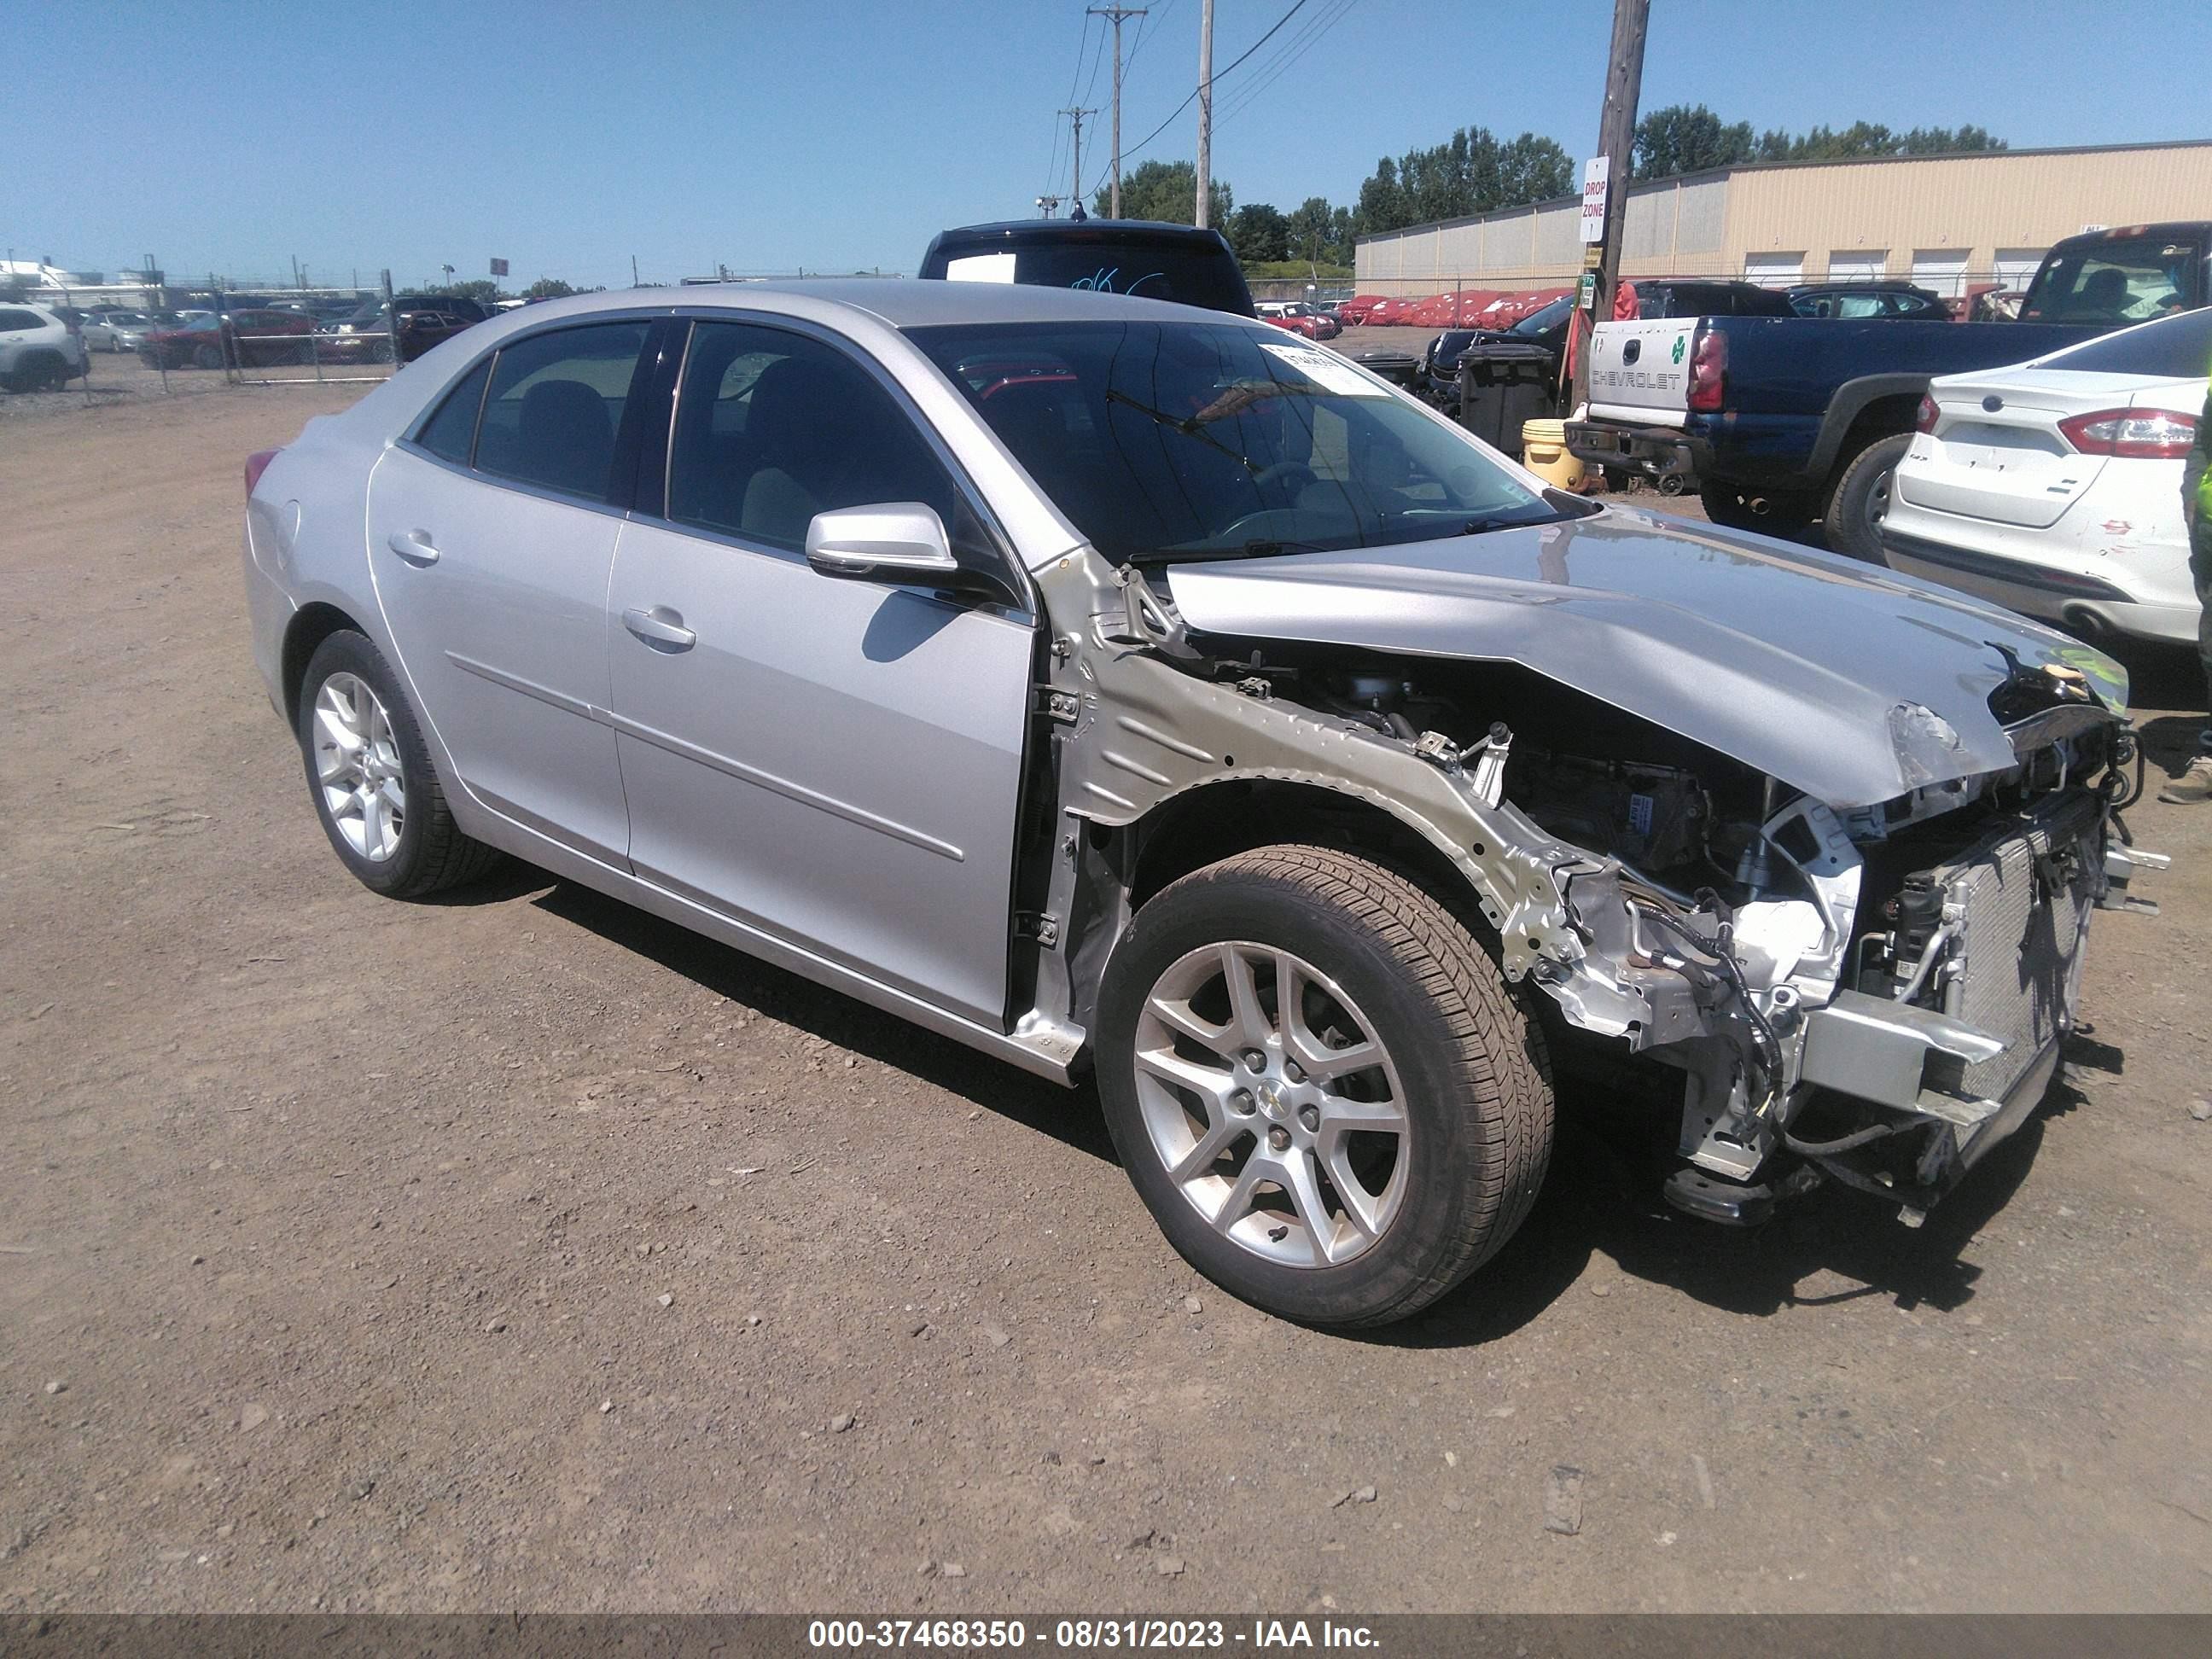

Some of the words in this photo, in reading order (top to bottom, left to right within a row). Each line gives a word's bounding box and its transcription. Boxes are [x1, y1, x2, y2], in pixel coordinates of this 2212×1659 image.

[1585, 181, 1606, 196] DROP
[1582, 203, 1604, 218] ZONE
[1592, 370, 1680, 390] CHEVROLET
